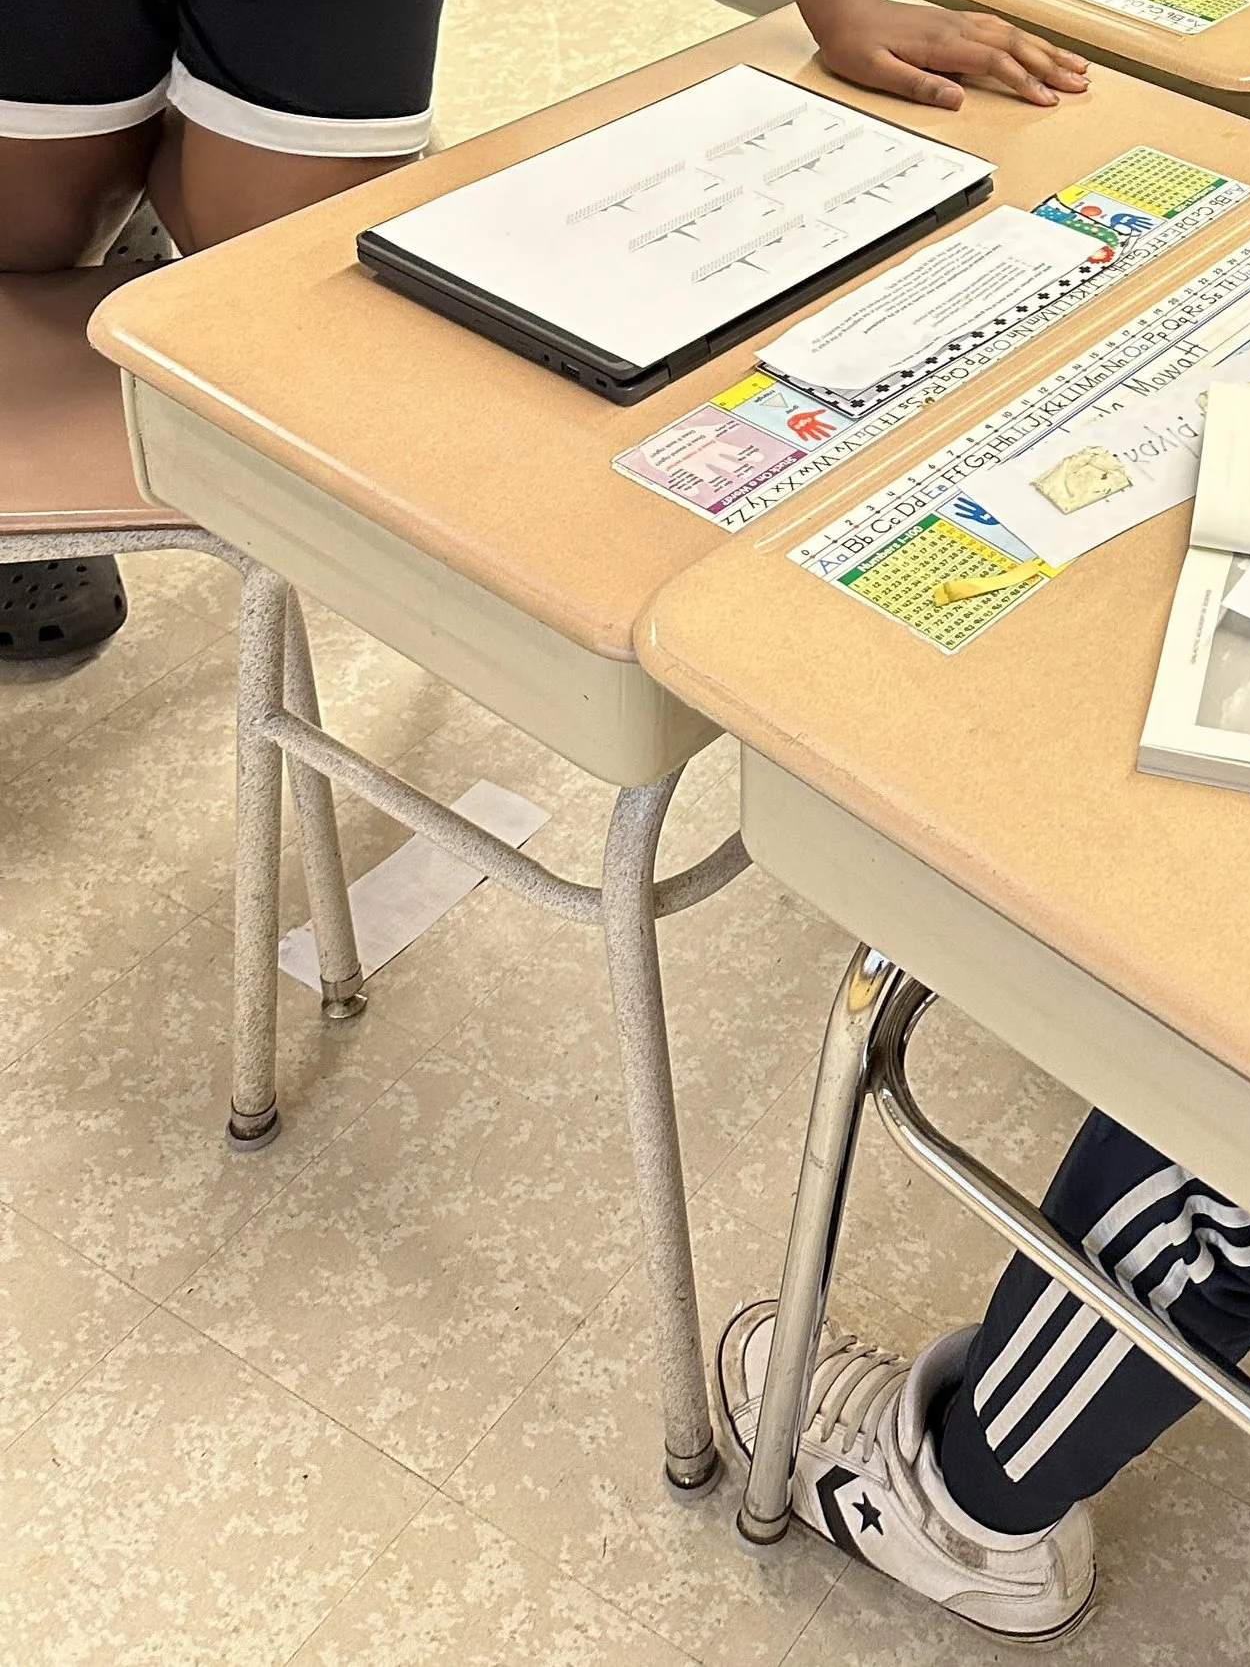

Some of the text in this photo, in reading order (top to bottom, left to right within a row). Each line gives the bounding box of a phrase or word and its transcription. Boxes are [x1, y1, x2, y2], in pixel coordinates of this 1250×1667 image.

[1027, 308, 1059, 326] Mm
[1007, 324, 1034, 338] Nn
[984, 339, 1012, 353] Oo
[961, 352, 992, 366] Pp
[1120, 340, 1209, 397] Mowatt
[818, 553, 849, 575] Aa
[841, 533, 874, 554] Bb
[870, 517, 901, 533] Cc
[894, 495, 927, 517] Dd
[920, 484, 949, 499] Ee
[941, 465, 969, 484] Ff
[964, 451, 1002, 468] Gg
[986, 434, 1018, 452] Hh
[1024, 413, 1053, 428] Jj
[1039, 400, 1068, 416] Kk
[1058, 382, 1084, 403] Ll
[1076, 371, 1109, 392] Mm
[1100, 359, 1130, 374] Nn
[1122, 344, 1149, 358] Oo
[1142, 331, 1171, 345] Pp
[1162, 317, 1199, 331] Qq
[1181, 304, 1204, 318] Rr
[1200, 292, 1223, 305] Ss
[1214, 279, 1238, 292] Tt
[878, 412, 906, 426] Tt
[834, 440, 863, 453] Vv
[772, 455, 798, 475] Stuck
[800, 455, 841, 477] Ww
[758, 470, 773, 483] On
[771, 476, 803, 493] Xx
[720, 484, 751, 506] Word?
[720, 507, 754, 526] Zz
[857, 542, 901, 573] Numbers
